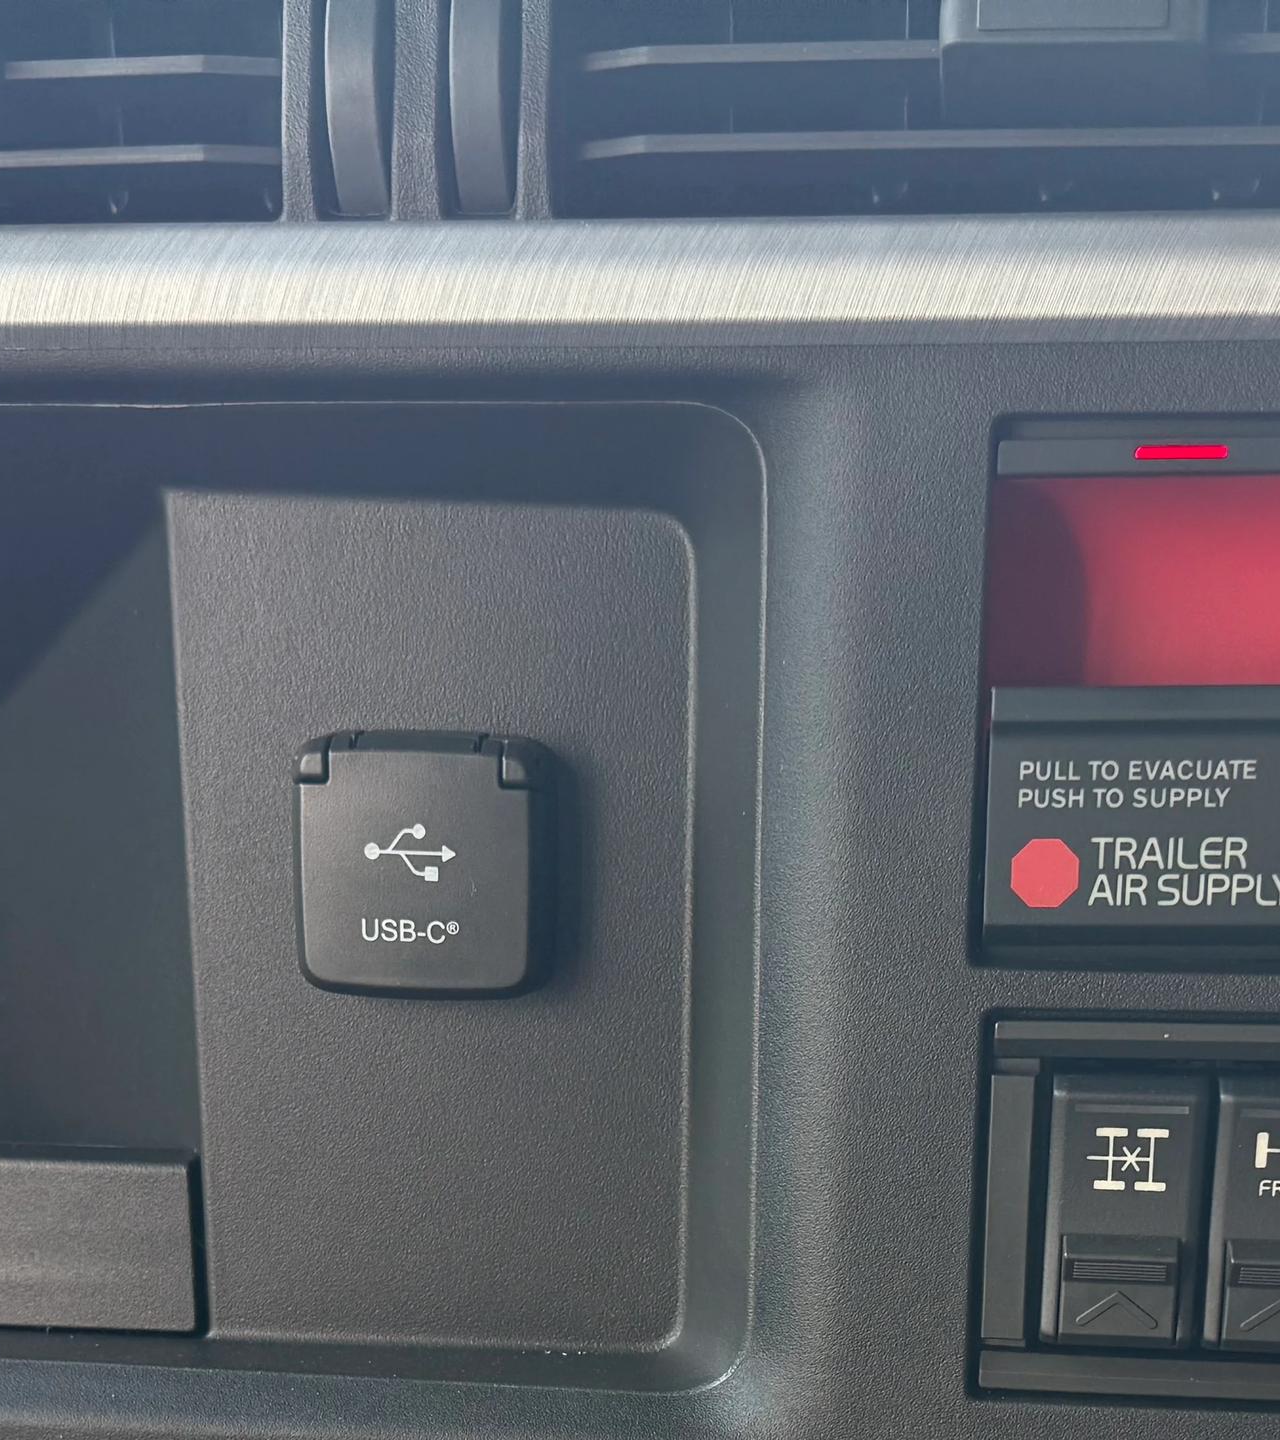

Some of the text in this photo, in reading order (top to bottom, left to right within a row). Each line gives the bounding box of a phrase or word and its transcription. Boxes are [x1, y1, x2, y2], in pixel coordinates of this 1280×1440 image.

[1018, 759, 1257, 782] PULL TO EVACUATE
[1017, 787, 1231, 810] PUSH TO SUPPLY
[1090, 836, 1248, 870] TRAILER
[1087, 873, 1148, 906] AIR
